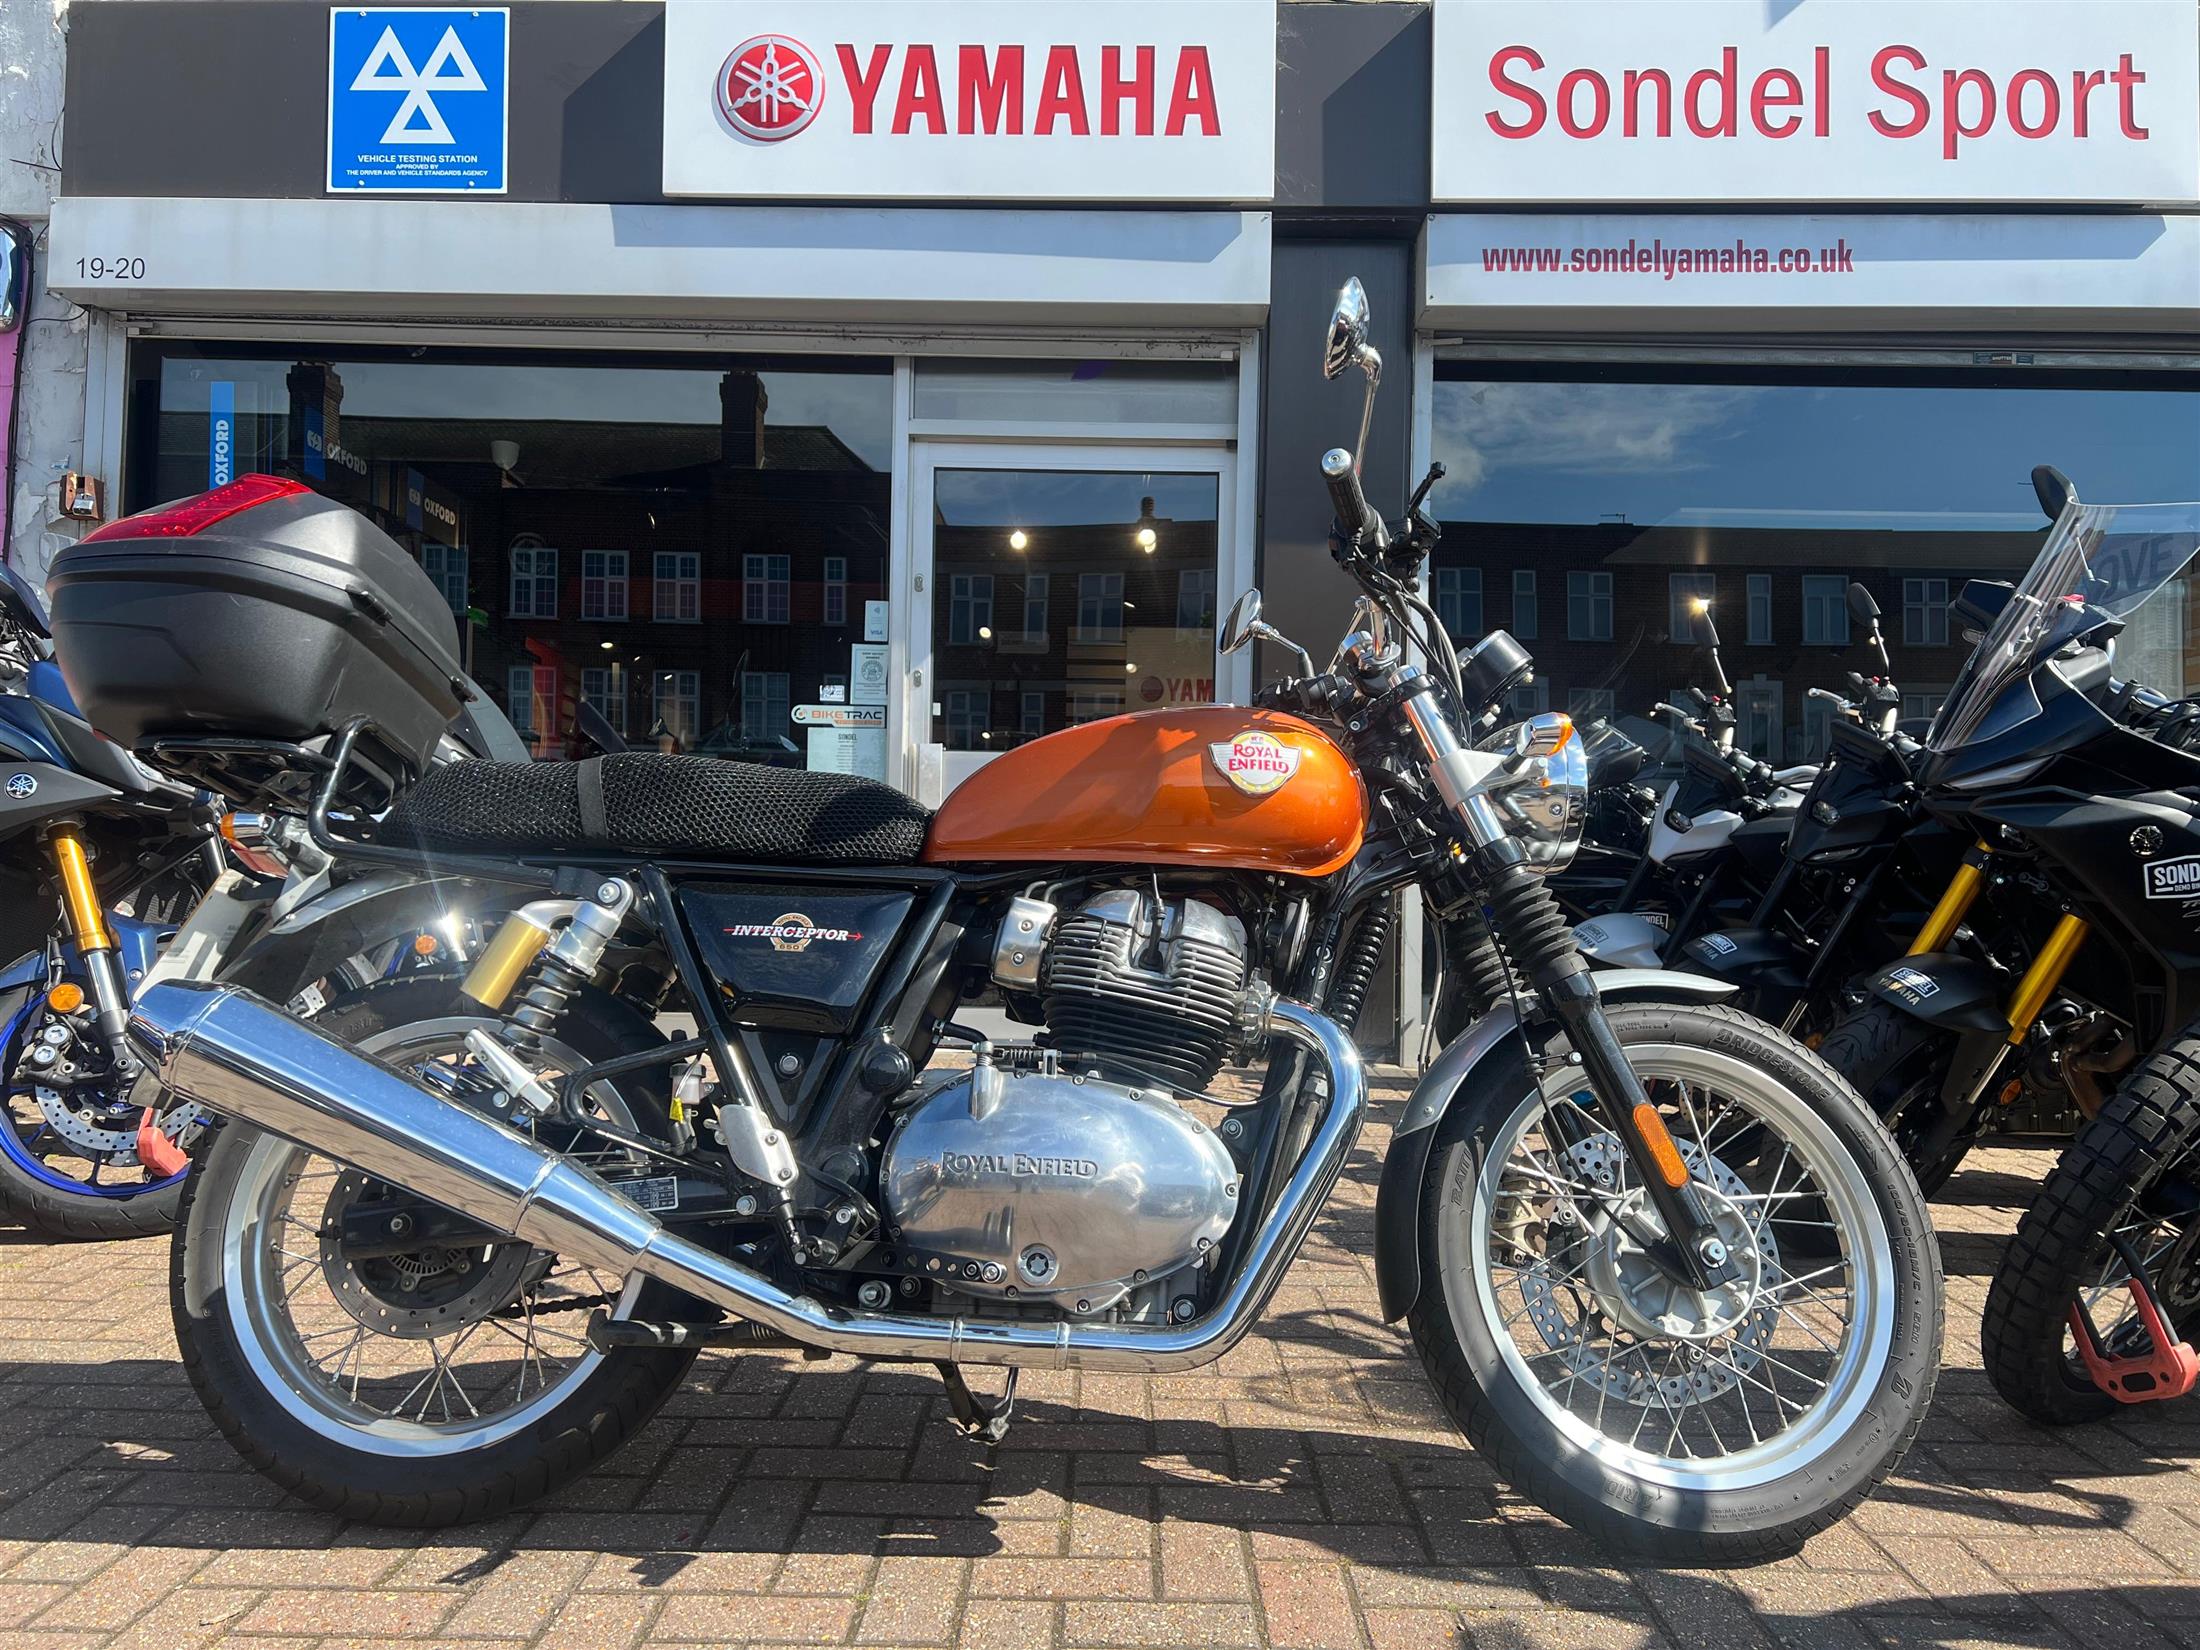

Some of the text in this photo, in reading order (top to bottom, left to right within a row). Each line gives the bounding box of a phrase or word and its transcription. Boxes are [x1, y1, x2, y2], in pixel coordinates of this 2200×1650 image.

[834, 44, 1222, 136] YAMAHA
[1484, 44, 2150, 161] Sondel Sport
[357, 155, 478, 163] VEHICLE TESTING STATION
[76, 257, 146, 280] 19-20
[1482, 238, 1854, 281] www.sondelyamaha.co.uk
[215, 419, 230, 486] OXFORD
[326, 442, 368, 477] OXFORD
[424, 497, 456, 526] OXFORD
[811, 710, 883, 720] BIKETRAC
[1234, 744, 1282, 758] ROYAL
[1228, 758, 1289, 774] ENFIELD
[732, 924, 849, 941] INTERCEPTOR
[1708, 1028, 1832, 1100] BRIDGESTONE
[941, 1151, 1099, 1180] ROYAL ENFIELD
